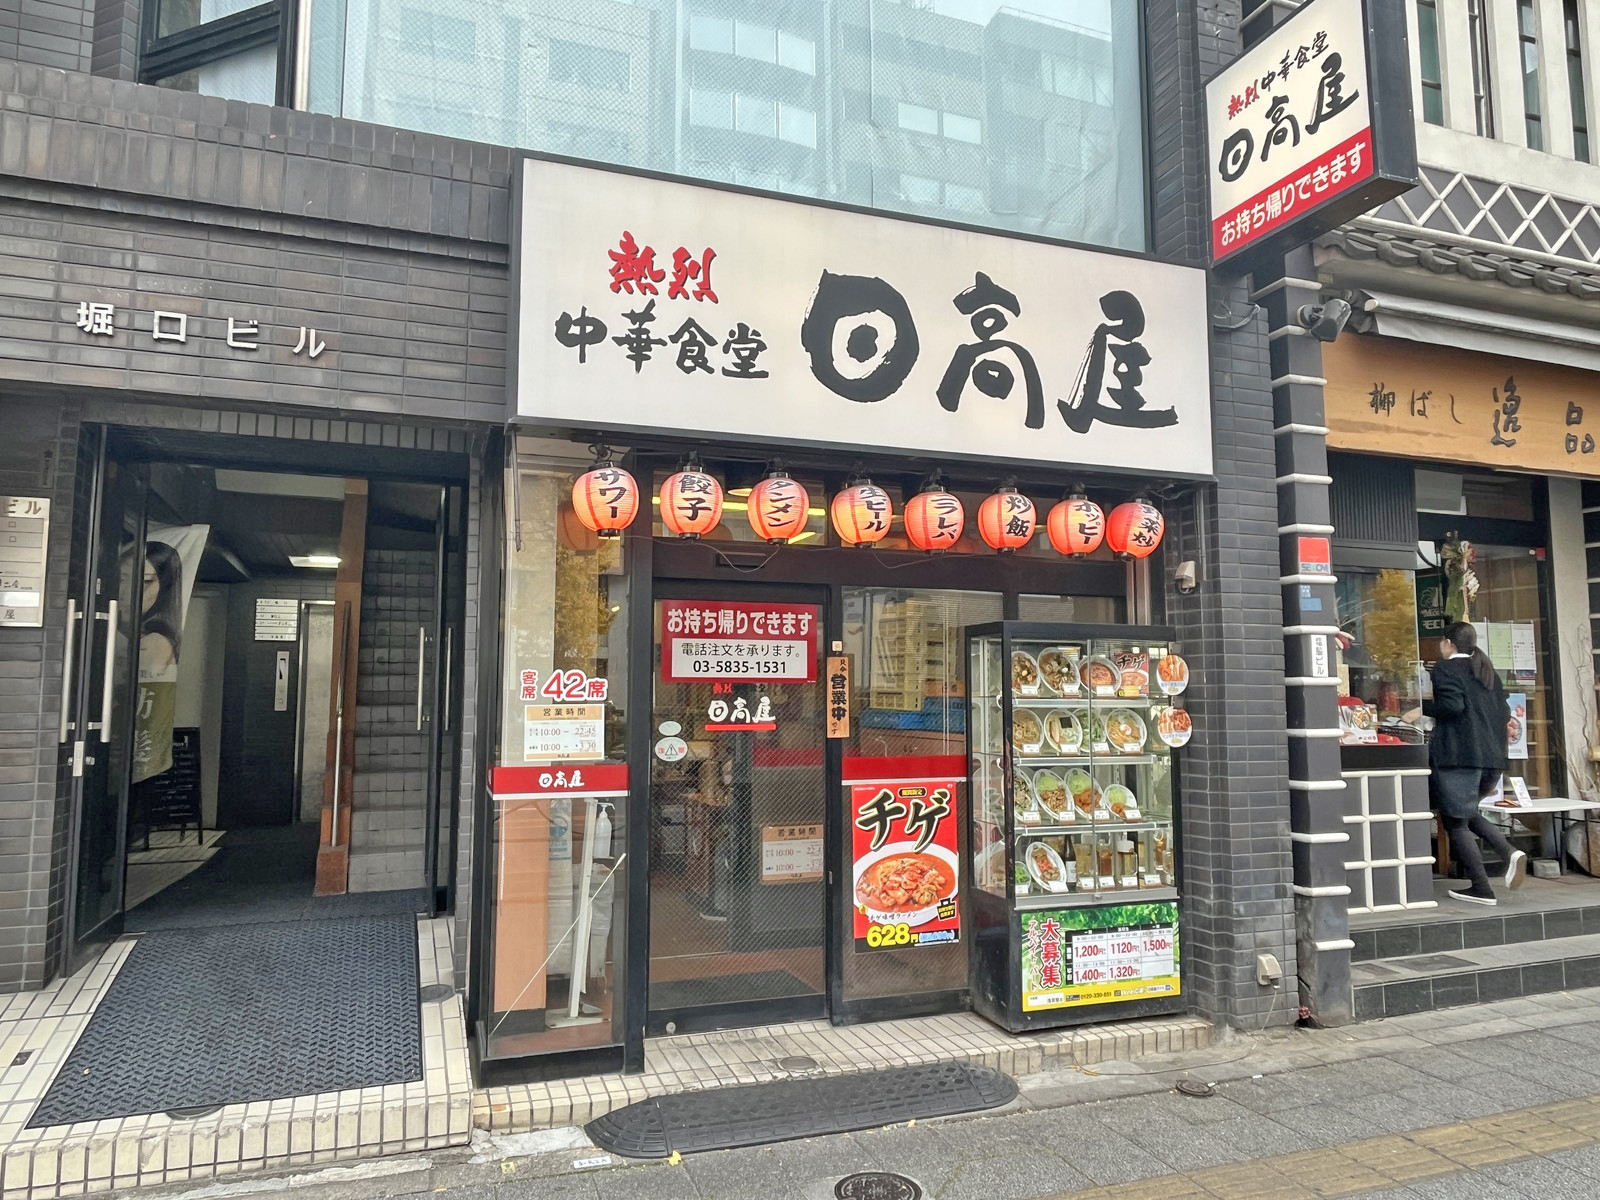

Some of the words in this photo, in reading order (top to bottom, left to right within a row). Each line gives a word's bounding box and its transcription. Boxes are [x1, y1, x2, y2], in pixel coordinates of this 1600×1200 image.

[1218, 52, 1360, 183] 日高屋
[1221, 141, 1366, 247] お持ち帰りできます
[608, 231, 719, 304] 熱烈
[77, 301, 326, 358] 堀口ビル
[555, 299, 770, 380] 中華食堂
[801, 268, 1178, 434] 日高屋
[593, 469, 627, 518] サワー
[677, 473, 712, 521] 餃子
[768, 480, 796, 527] タンメン
[858, 485, 887, 532] 生ビール
[1006, 495, 1031, 538] 炒飯
[931, 495, 958, 540] ニラレバ
[1074, 501, 1101, 545] ホッピー
[667, 608, 813, 636] お持ち帰りできます
[681, 642, 801, 658] 電話注文を承ります。
[693, 660, 786, 674] 03-5835-1531
[1116, 655, 1146, 671] チゲ
[521, 671, 537, 699] 客席
[831, 673, 848, 720] 営業中
[543, 707, 586, 717] 営業時間
[708, 696, 776, 723] 日高屋
[539, 769, 585, 788] 日高屋
[855, 788, 951, 853] チゲ
[1041, 918, 1061, 986] 大募集
